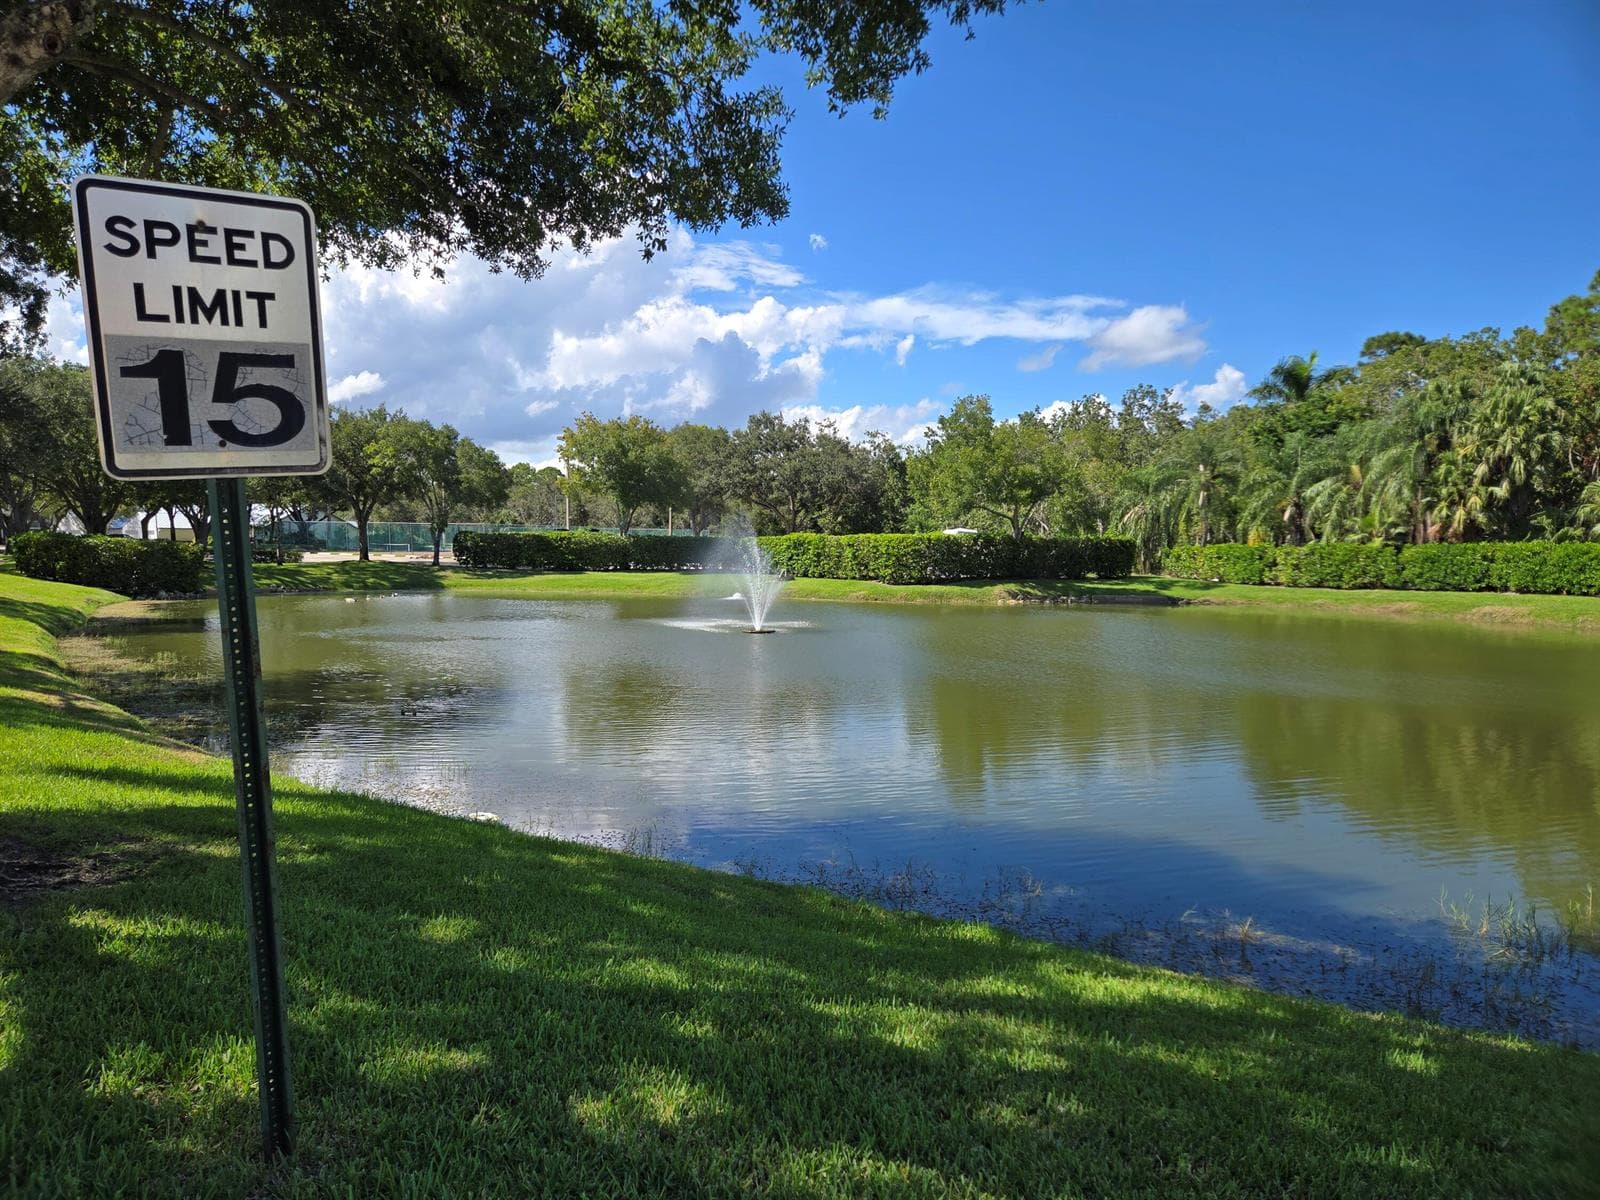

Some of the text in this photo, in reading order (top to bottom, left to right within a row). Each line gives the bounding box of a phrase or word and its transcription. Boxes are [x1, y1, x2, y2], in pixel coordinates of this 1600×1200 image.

[103, 215, 295, 270] SPEED
[133, 282, 276, 329] LIMIT
[119, 349, 305, 448] 15
